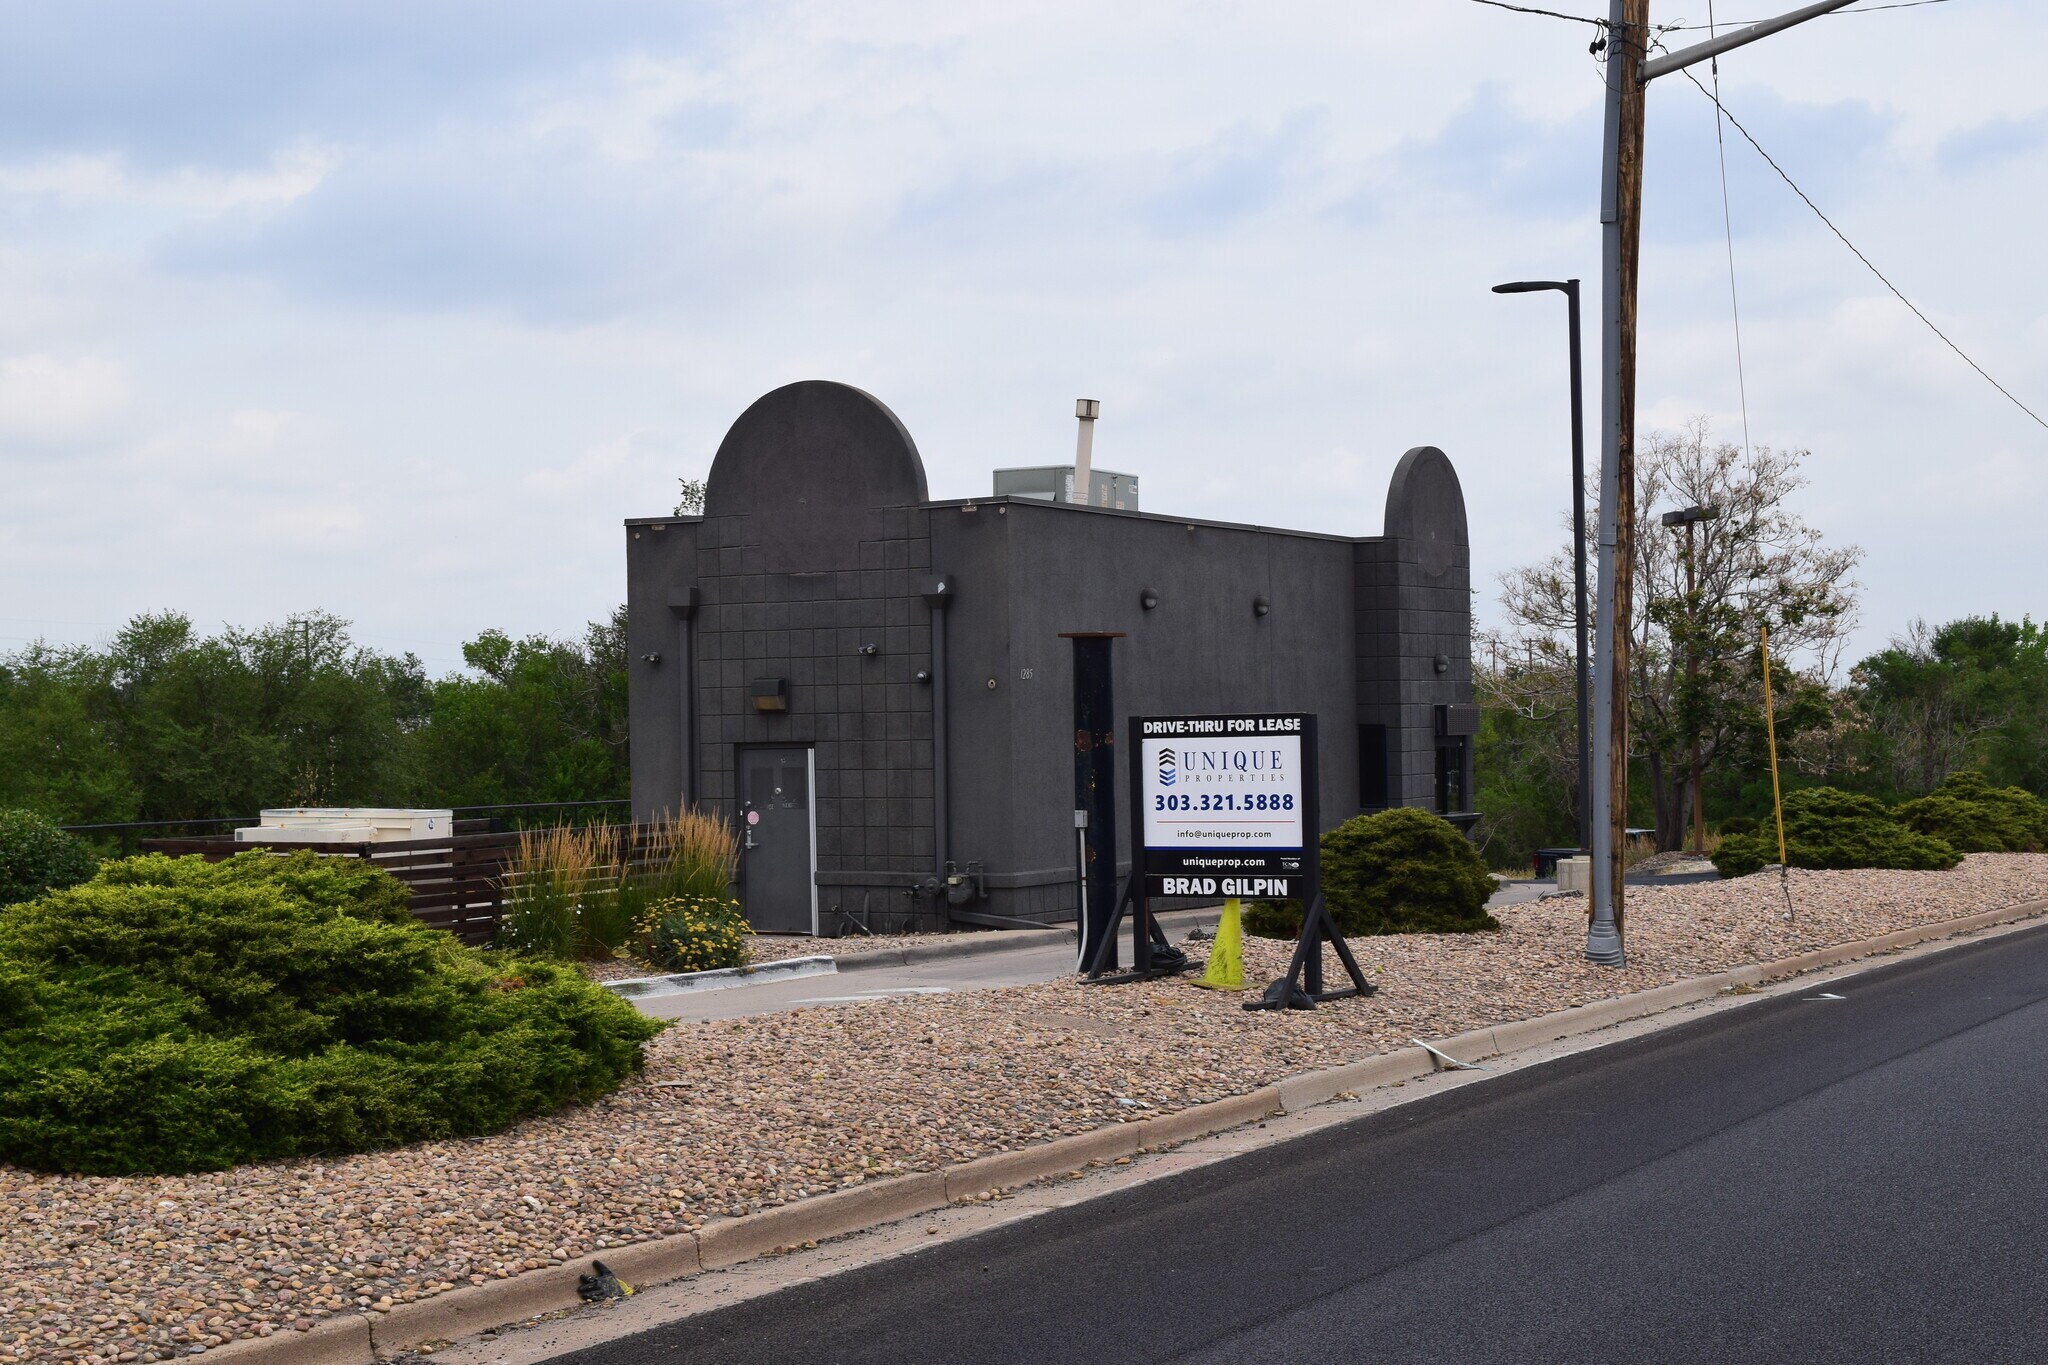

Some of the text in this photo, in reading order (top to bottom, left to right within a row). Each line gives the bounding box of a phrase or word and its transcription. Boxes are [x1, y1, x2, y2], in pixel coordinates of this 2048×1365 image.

[1143, 718, 1301, 734] DRIVE-THRU FOR LEASE
[1184, 751, 1283, 772] UNIQUE
[1185, 774, 1285, 783] PROPERTIES
[1155, 794, 1294, 811] 303.321.5888
[1177, 829, 1272, 840] info@uniqueprop.com
[1183, 857, 1265, 868] uniqueprop.com
[1163, 877, 1288, 896] BRAD GILPIN
